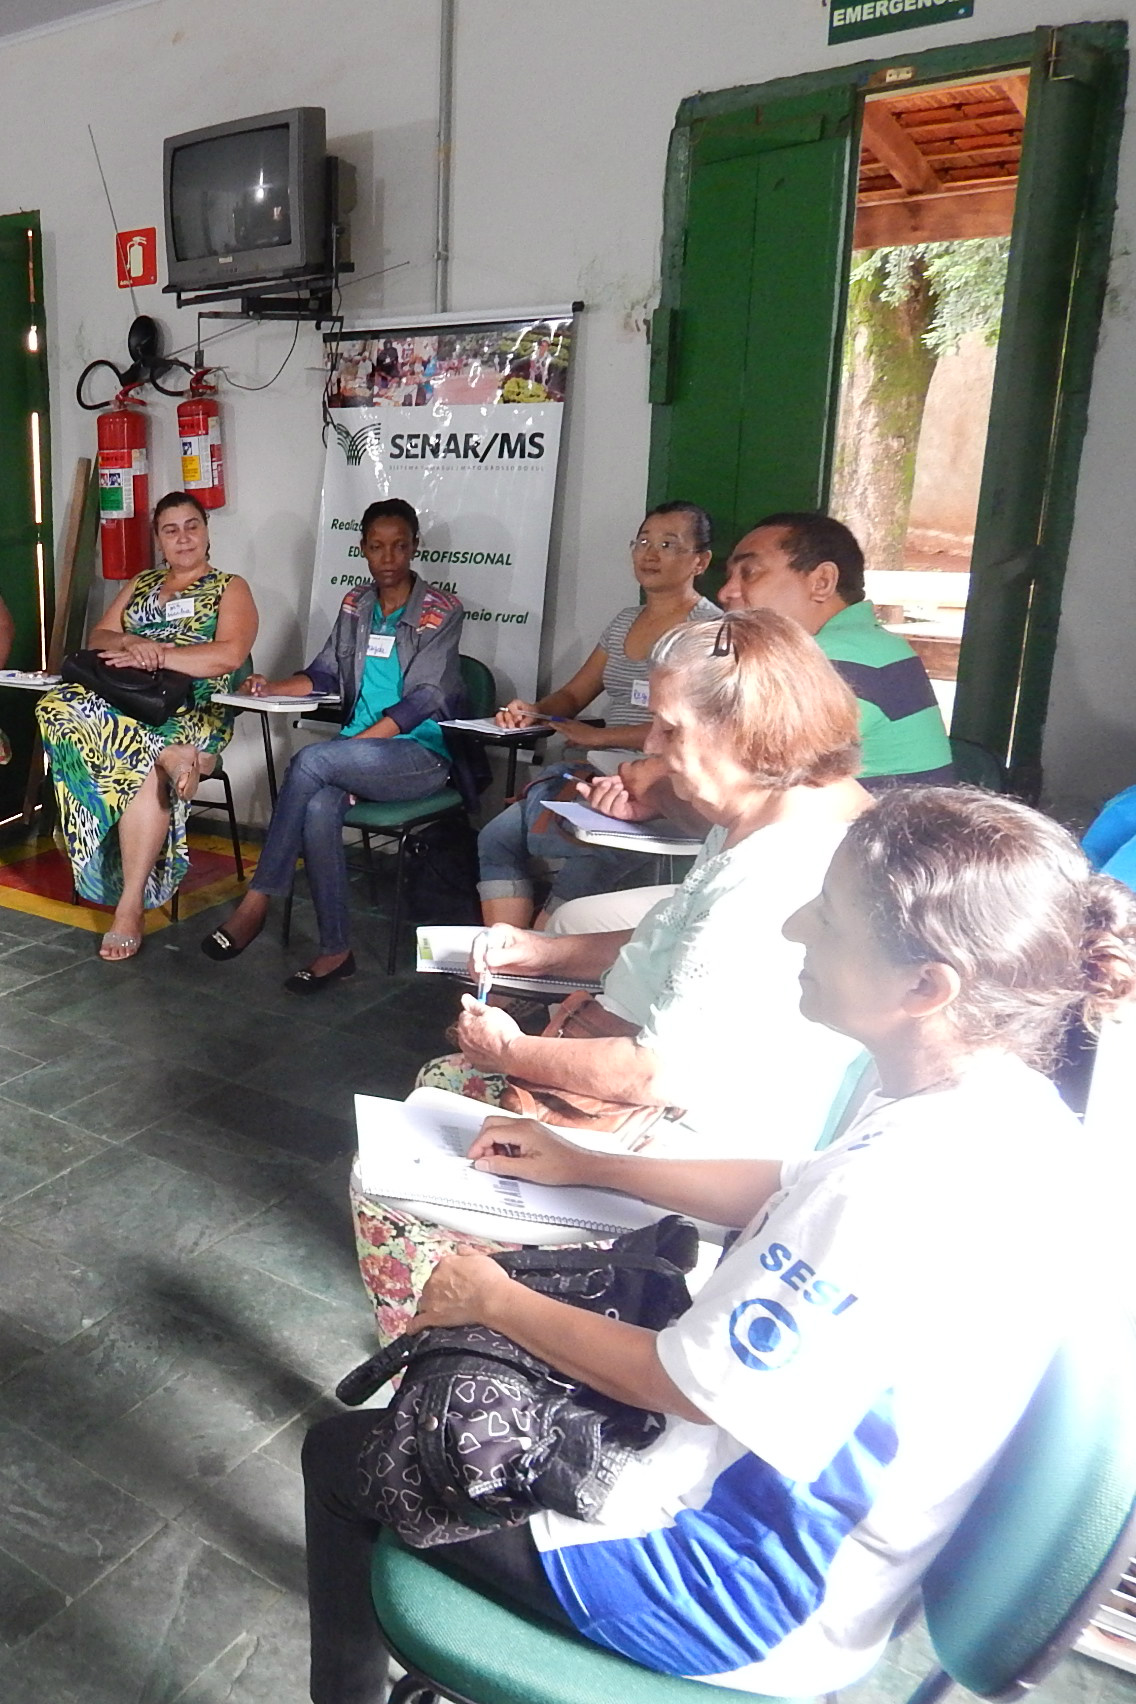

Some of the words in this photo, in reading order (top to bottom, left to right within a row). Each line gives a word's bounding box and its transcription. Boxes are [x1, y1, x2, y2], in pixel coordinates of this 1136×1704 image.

[390, 432, 545, 463] SENAR/MS
[331, 576, 338, 585] e
[495, 612, 529, 624] rural
[760, 1243, 858, 1315] SESI
